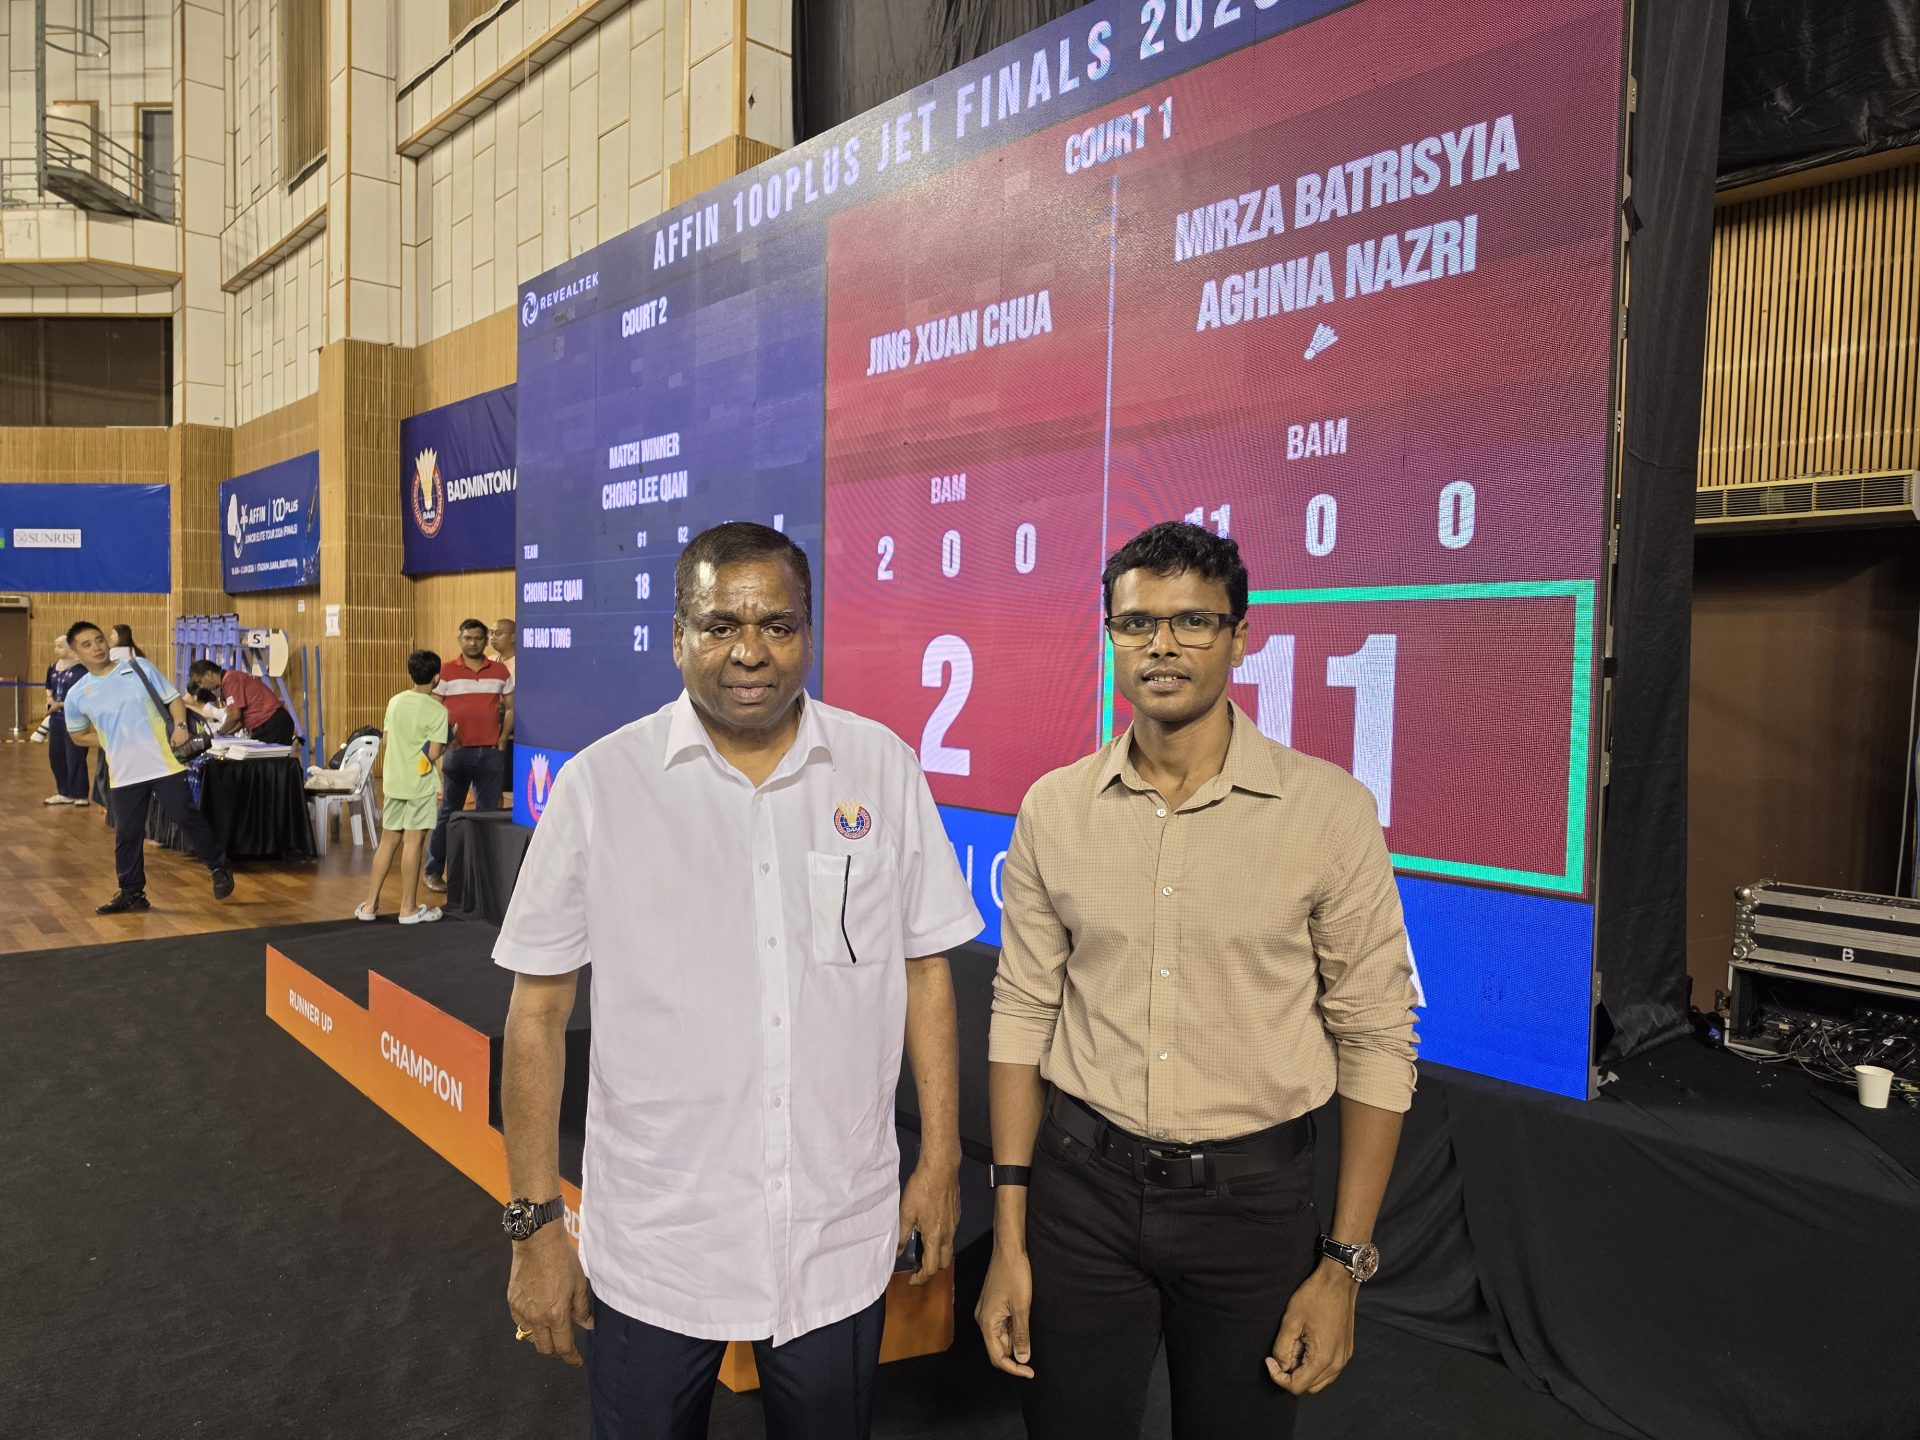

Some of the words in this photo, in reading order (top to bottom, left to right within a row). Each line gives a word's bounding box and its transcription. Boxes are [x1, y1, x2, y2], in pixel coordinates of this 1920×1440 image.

[653, 202, 720, 270] AFFIN
[732, 135, 862, 234] 100PLUS
[876, 99, 938, 173] JET
[955, 19, 1113, 140] FINALS
[1139, 0, 1279, 61] 20
[1063, 103, 1152, 176] COURT
[1158, 95, 1174, 141] 1
[1173, 183, 1286, 263] MIRZA
[1293, 113, 1521, 230] BATRISYIA
[540, 271, 600, 311] REVEALTEK
[1195, 250, 1336, 333] AGHNIA
[1344, 213, 1479, 299] NAZRI
[621, 299, 658, 339] COURT
[658, 295, 668, 325] 2
[866, 327, 911, 377] JING
[914, 308, 979, 366] XUAN
[982, 289, 1053, 349] CHUA
[609, 440, 640, 470] MATCH
[641, 431, 680, 463] WINNER
[1286, 416, 1349, 461] BAM
[446, 467, 511, 503] BADMINTON
[602, 479, 637, 511] CHONG
[638, 475, 659, 505] LEE
[659, 469, 689, 502] QIAN
[930, 472, 967, 505] BAM
[249, 505, 266, 526] AFFIN
[1305, 493, 1339, 557] 0
[1437, 480, 1477, 550] 0
[28, 532, 80, 545] SUNRISE
[523, 543, 539, 560] TEAM
[876, 535, 895, 581] 2
[941, 529, 962, 579] 0
[1014, 522, 1037, 574] 0
[523, 581, 548, 603] CHONG
[548, 580, 563, 602] LEE
[563, 578, 583, 603] QIAN
[635, 572, 650, 600] 18
[252, 633, 261, 645] 5
[523, 627, 534, 648] NG
[534, 627, 550, 648] HAO
[550, 627, 572, 649] TONG
[633, 624, 649, 652] 21
[919, 633, 974, 777] 2
[1232, 633, 1398, 829] 11
[1841, 948, 1855, 962] B
[289, 988, 320, 1027] RUNNER
[321, 1010, 333, 1035] UP
[380, 1030, 463, 1113] CHAMPION
